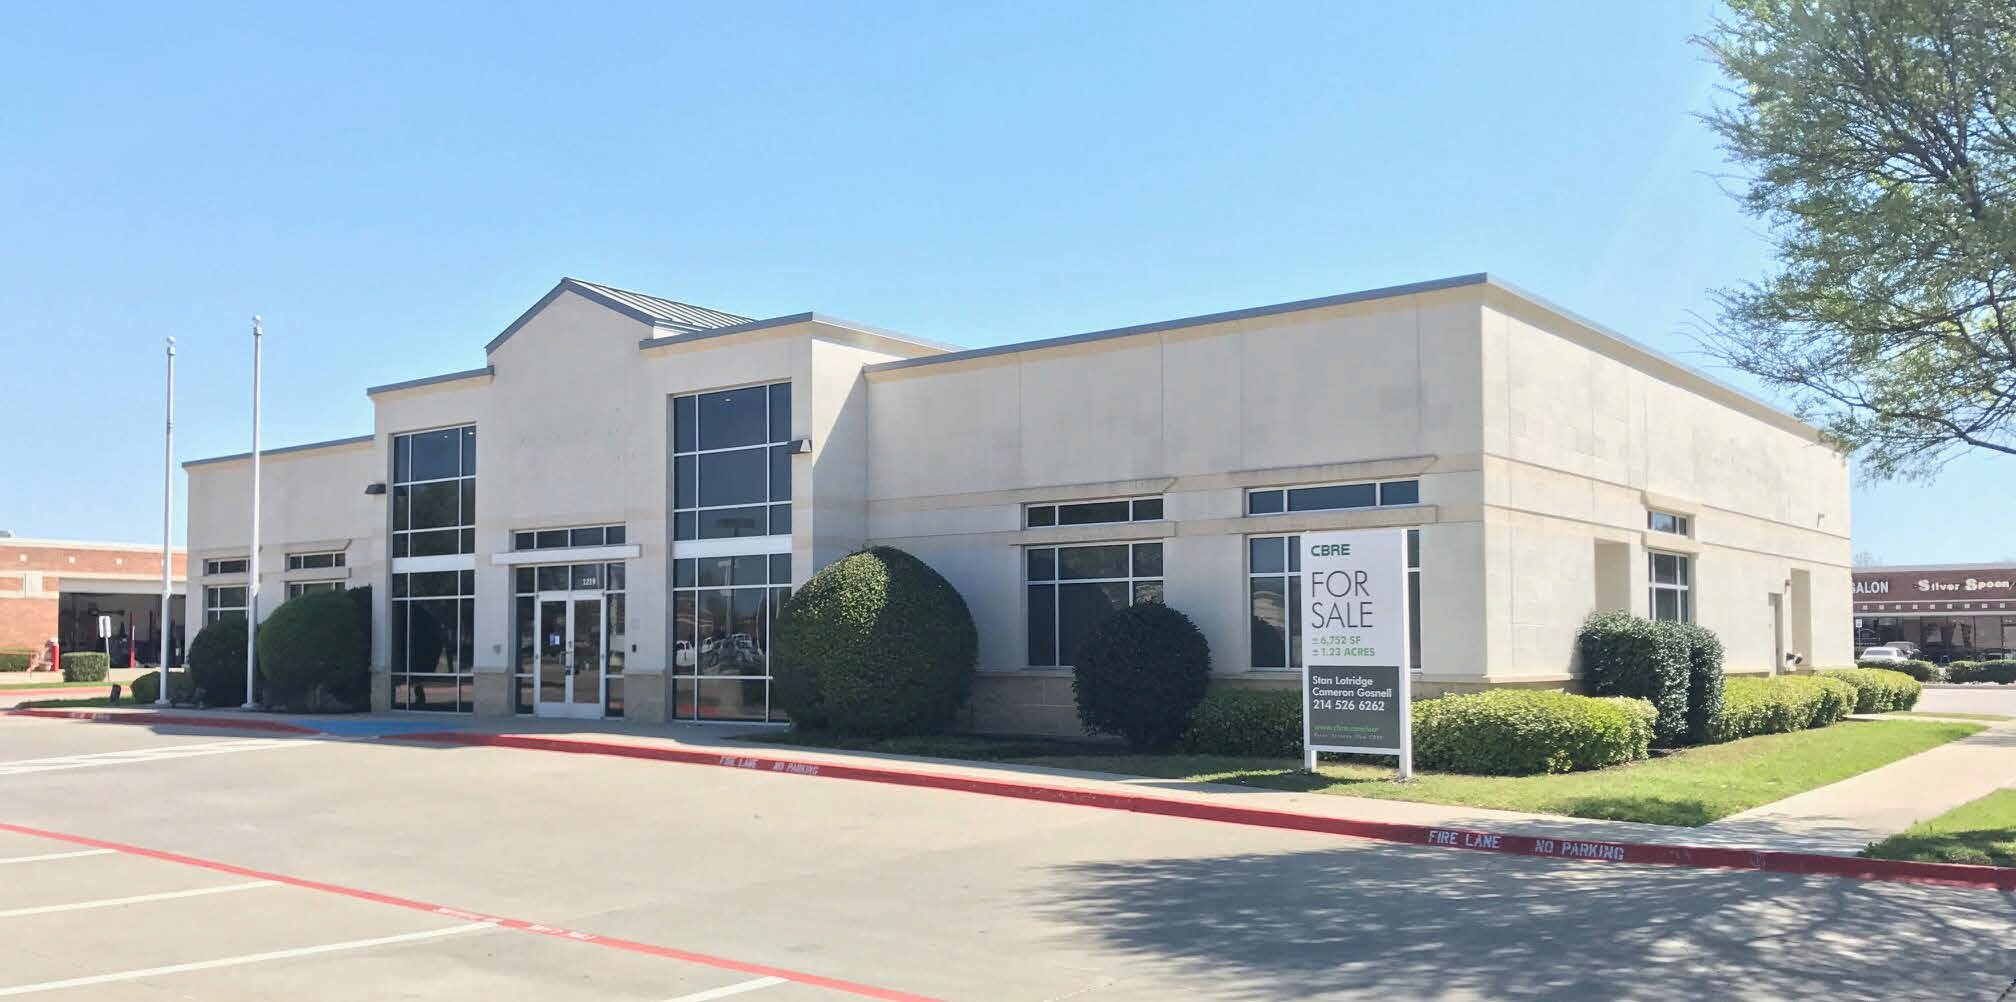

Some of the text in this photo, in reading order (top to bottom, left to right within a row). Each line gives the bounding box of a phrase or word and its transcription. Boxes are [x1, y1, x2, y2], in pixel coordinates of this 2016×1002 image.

[1311, 544, 1350, 557] CBRE
[1312, 570, 1370, 598] FOR
[1918, 578, 2010, 592] Silver Spoon
[1312, 601, 1373, 629] SALE
[1349, 636, 1361, 645] SF
[1344, 647, 1376, 657] ACRES
[1312, 675, 1333, 685] Stan
[1312, 686, 1392, 698] Cameron Gosnell
[1313, 699, 1385, 711] 214 526 6262
[1428, 830, 1625, 860] FIRE LANE NO PARKING
